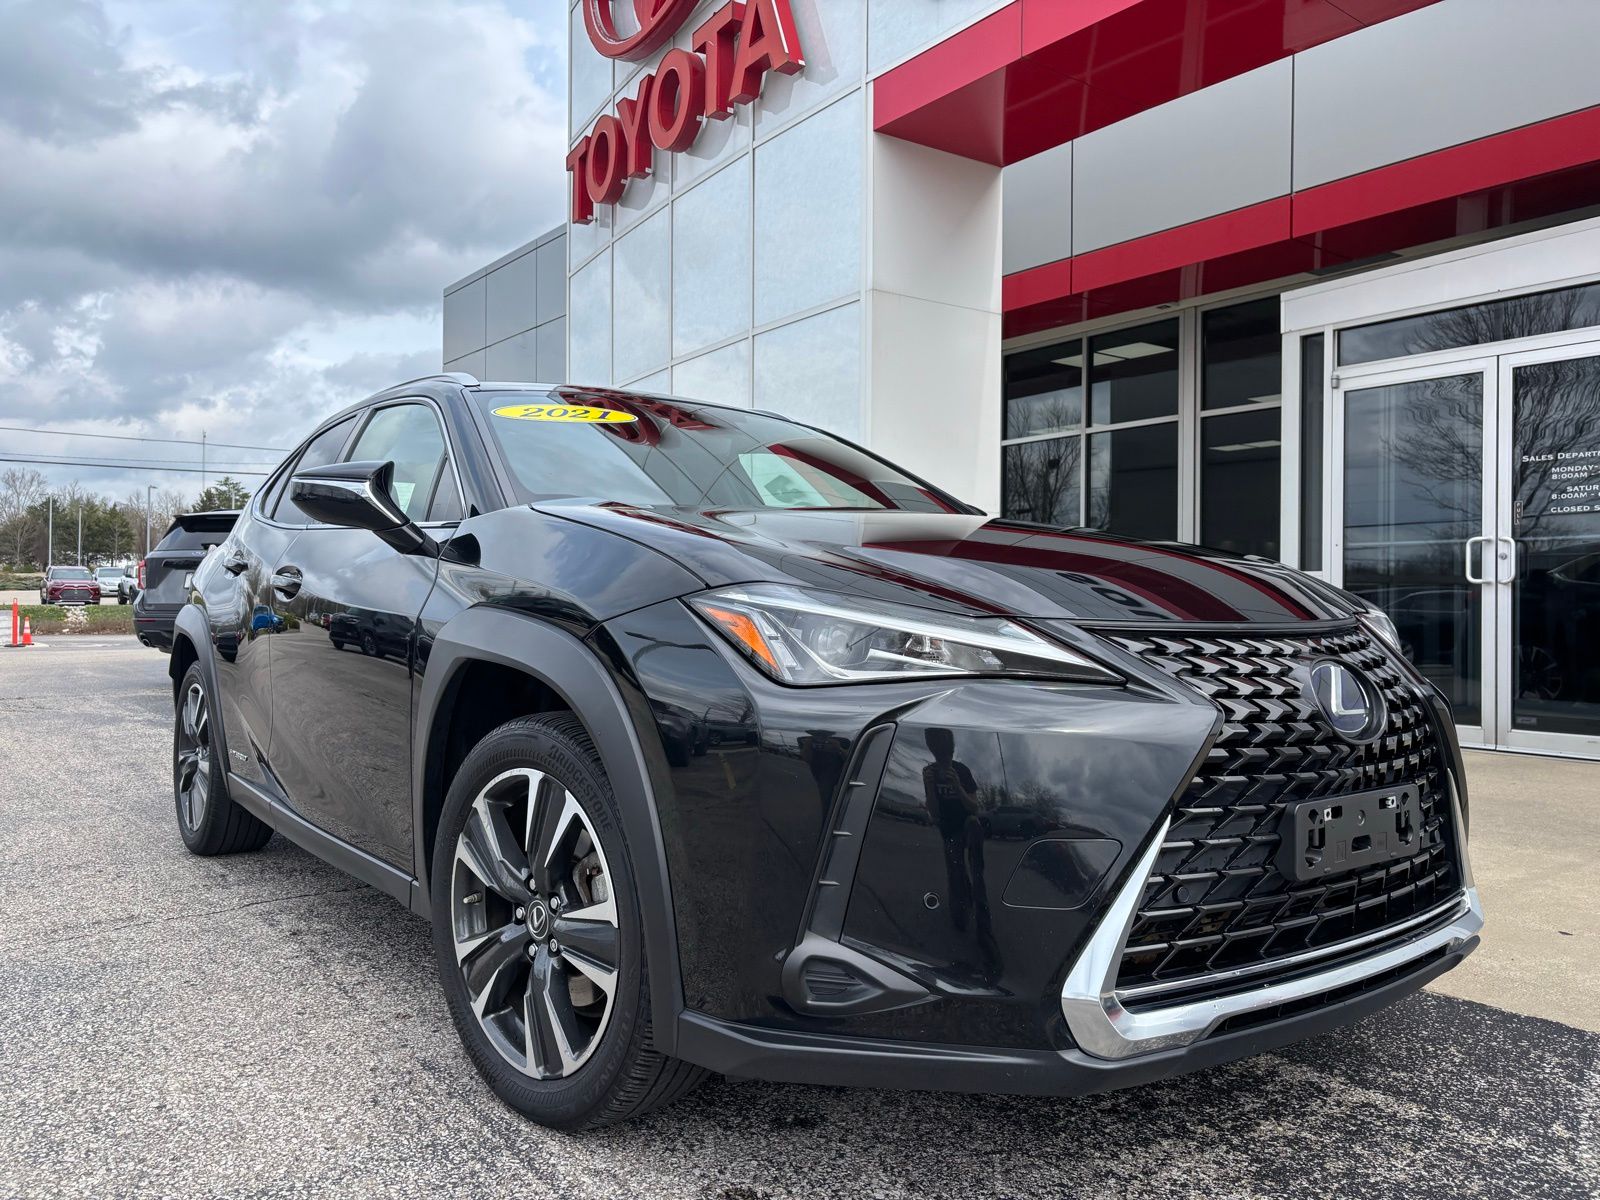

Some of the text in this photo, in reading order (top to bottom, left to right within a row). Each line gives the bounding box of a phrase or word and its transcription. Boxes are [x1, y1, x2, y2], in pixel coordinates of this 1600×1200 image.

[566, 0, 804, 224] TOYOTA
[519, 407, 612, 420] 2021
[1522, 454, 1554, 462] SALES
[1551, 472, 1588, 480] 8:00AM
[1551, 492, 1588, 500] 8:00AM
[1550, 505, 1590, 513] CLOSED
[547, 744, 614, 834] BRIDGESTONE
